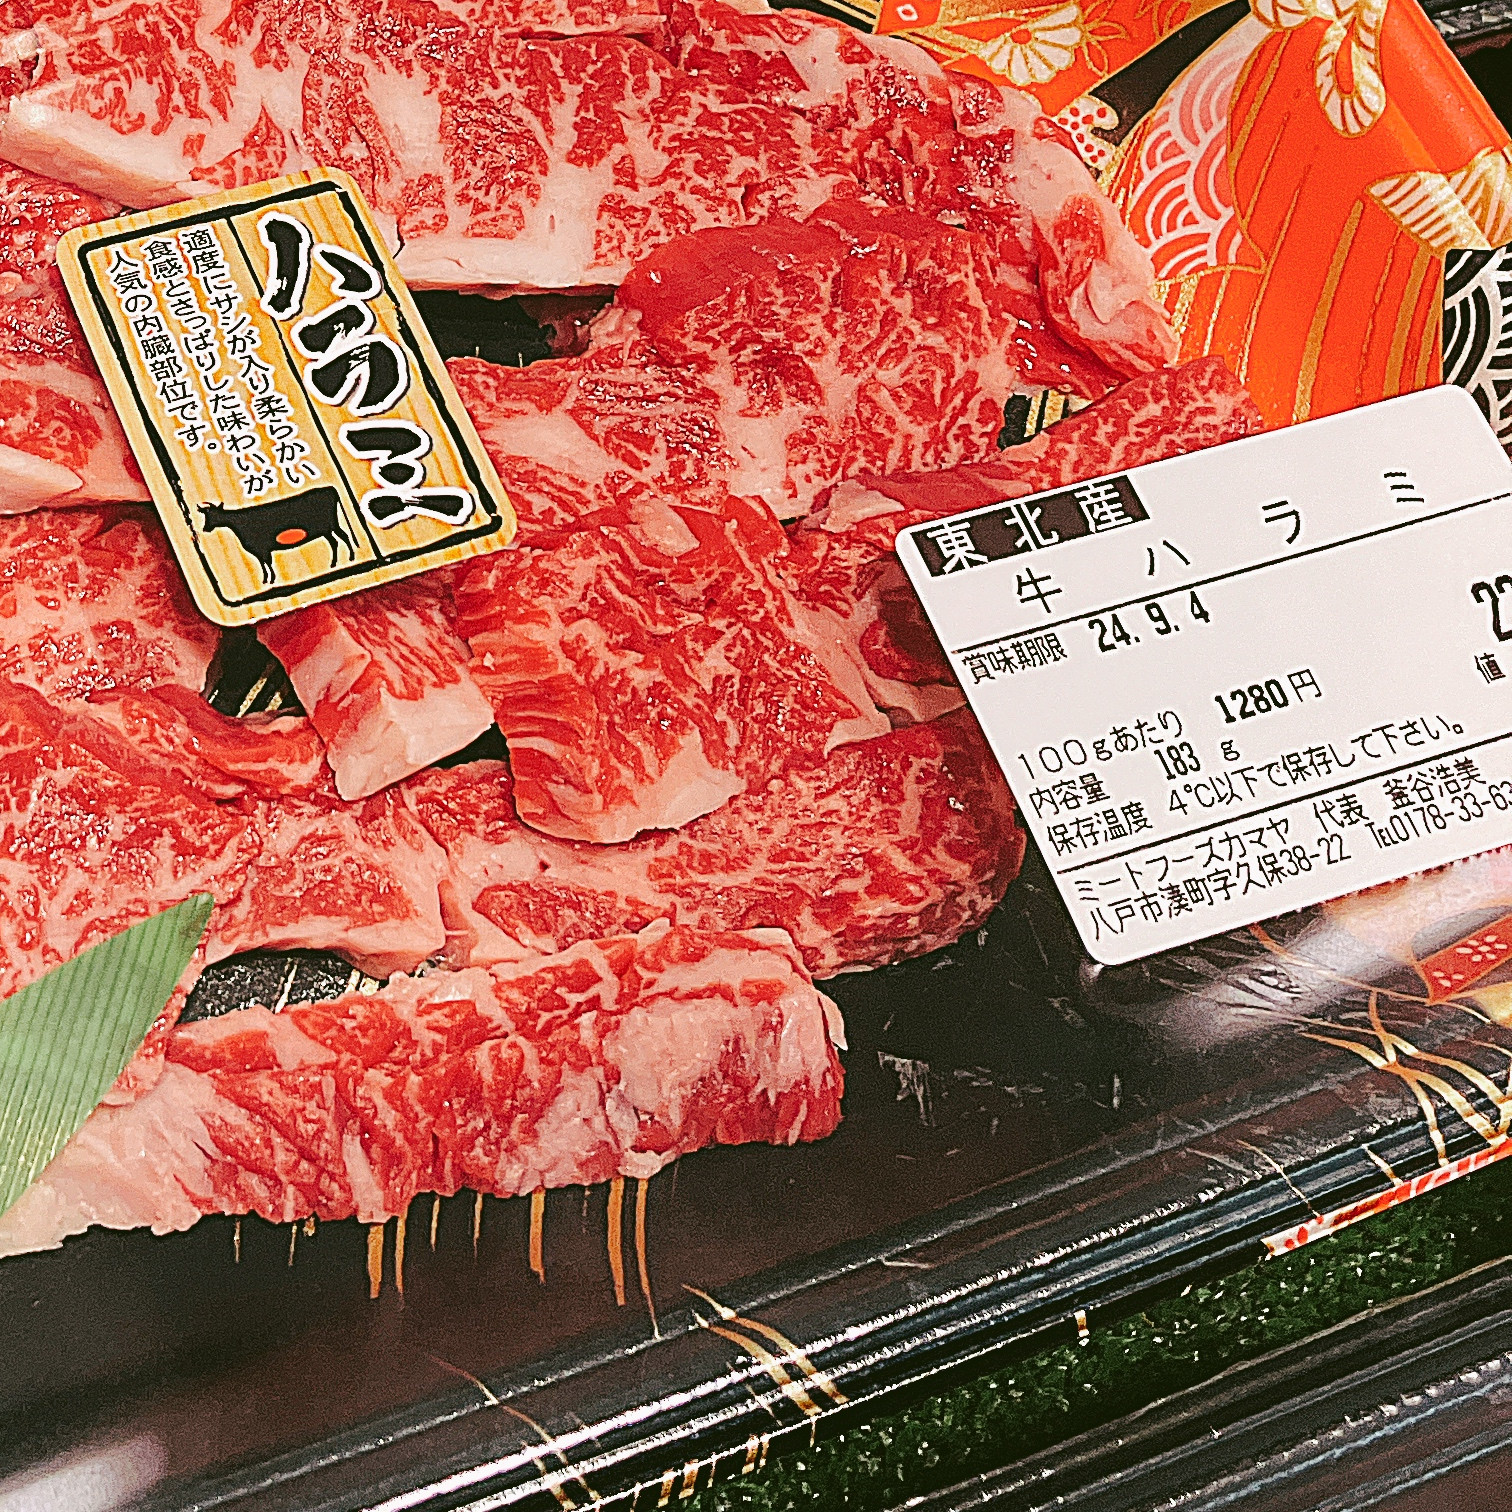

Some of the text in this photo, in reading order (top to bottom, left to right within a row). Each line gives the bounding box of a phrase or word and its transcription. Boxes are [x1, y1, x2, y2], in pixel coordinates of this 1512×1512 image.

[112, 251, 221, 451] 人気の内臓部位です。
[144, 240, 273, 496] 食感とさっぱりした味わいが
[183, 229, 316, 484] 適度にサシが入り柔らかい
[263, 218, 468, 522] ハラミ
[962, 633, 1068, 684] 賞味期限
[1029, 773, 1110, 819] 内容量
[1154, 742, 1201, 780] 183
[1046, 801, 1153, 856] 保存温度
[1313, 793, 1370, 834] 代表
